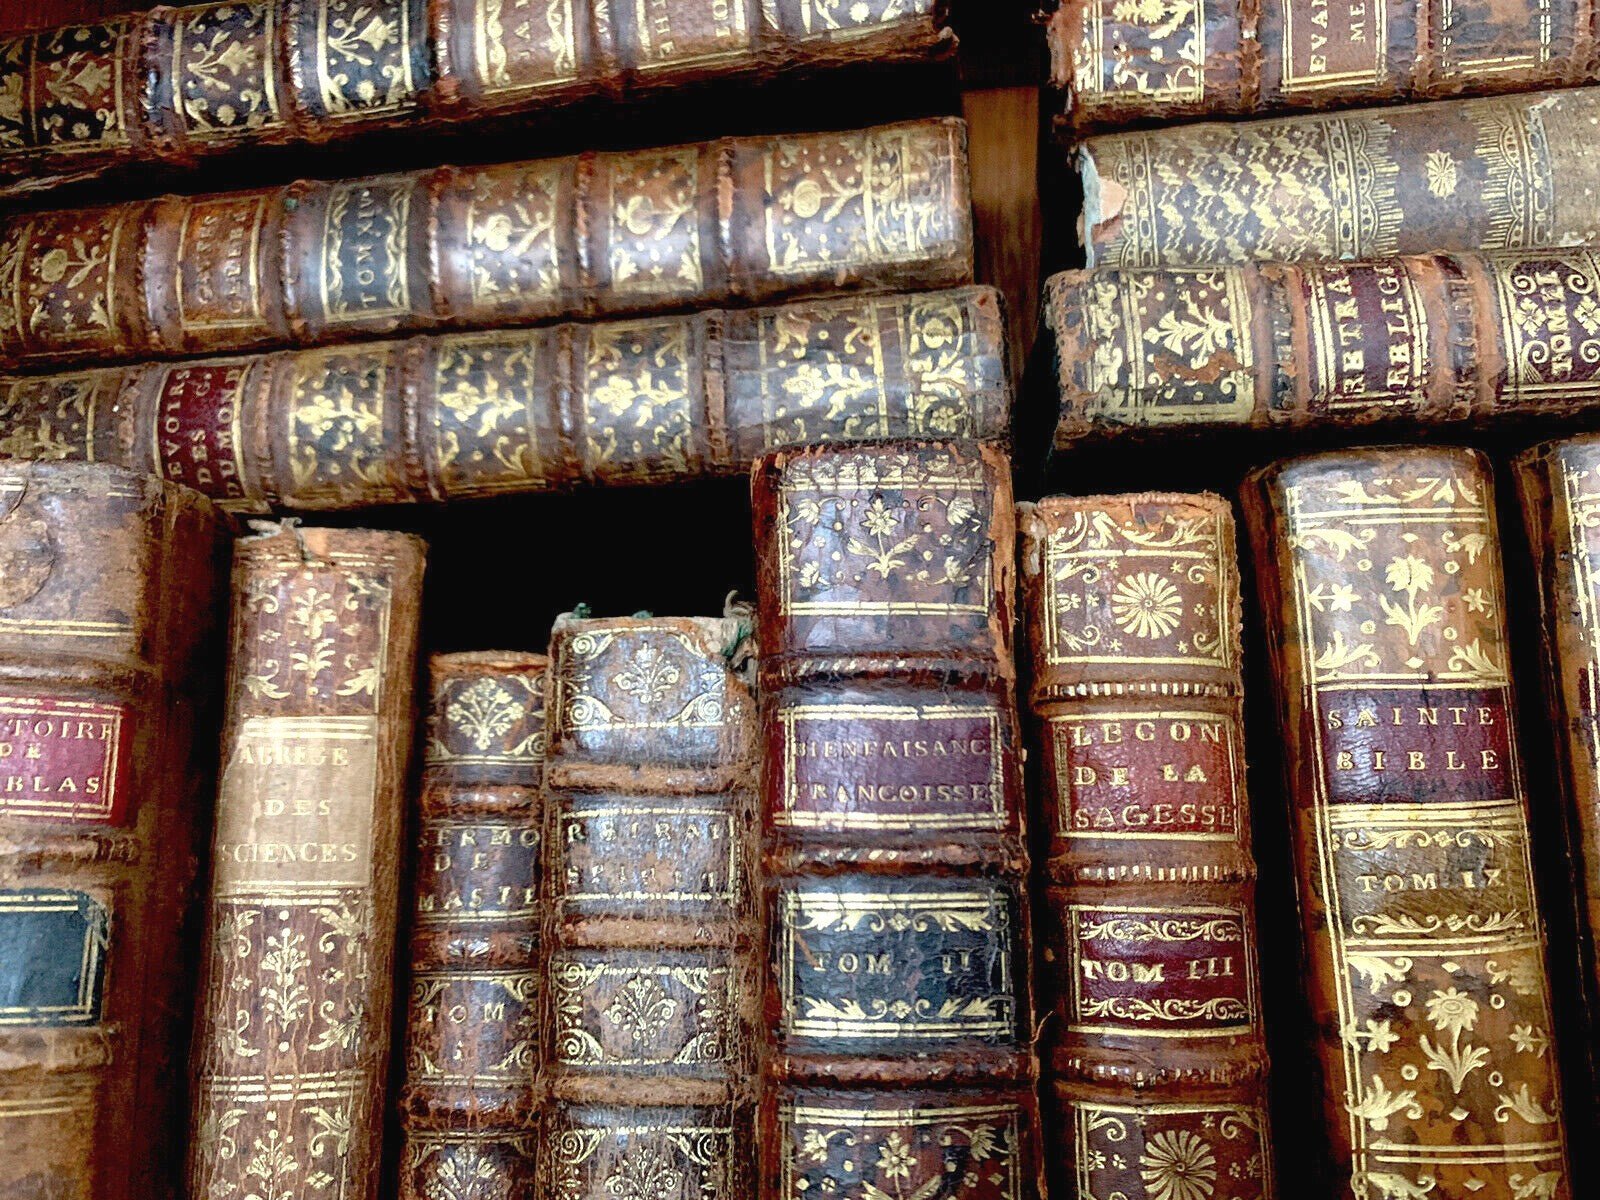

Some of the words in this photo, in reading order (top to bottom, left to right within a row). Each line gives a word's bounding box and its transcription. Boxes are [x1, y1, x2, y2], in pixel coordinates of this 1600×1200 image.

[357, 244, 377, 308] TOM
[191, 430, 213, 484] DES
[1327, 706, 1494, 730] SAINTE
[1336, 750, 1499, 771] BIBLE
[5, 776, 100, 794] BLAS
[1073, 766, 1130, 786] DE
[1161, 764, 1208, 783] LA
[264, 800, 331, 816] DES
[221, 842, 358, 863] SCIENCES
[435, 852, 488, 872] DE
[1355, 873, 1437, 892] TOM
[1461, 868, 1504, 888] IX
[813, 953, 893, 975] TOM
[1081, 958, 1166, 983] TOM
[1187, 956, 1234, 980] III
